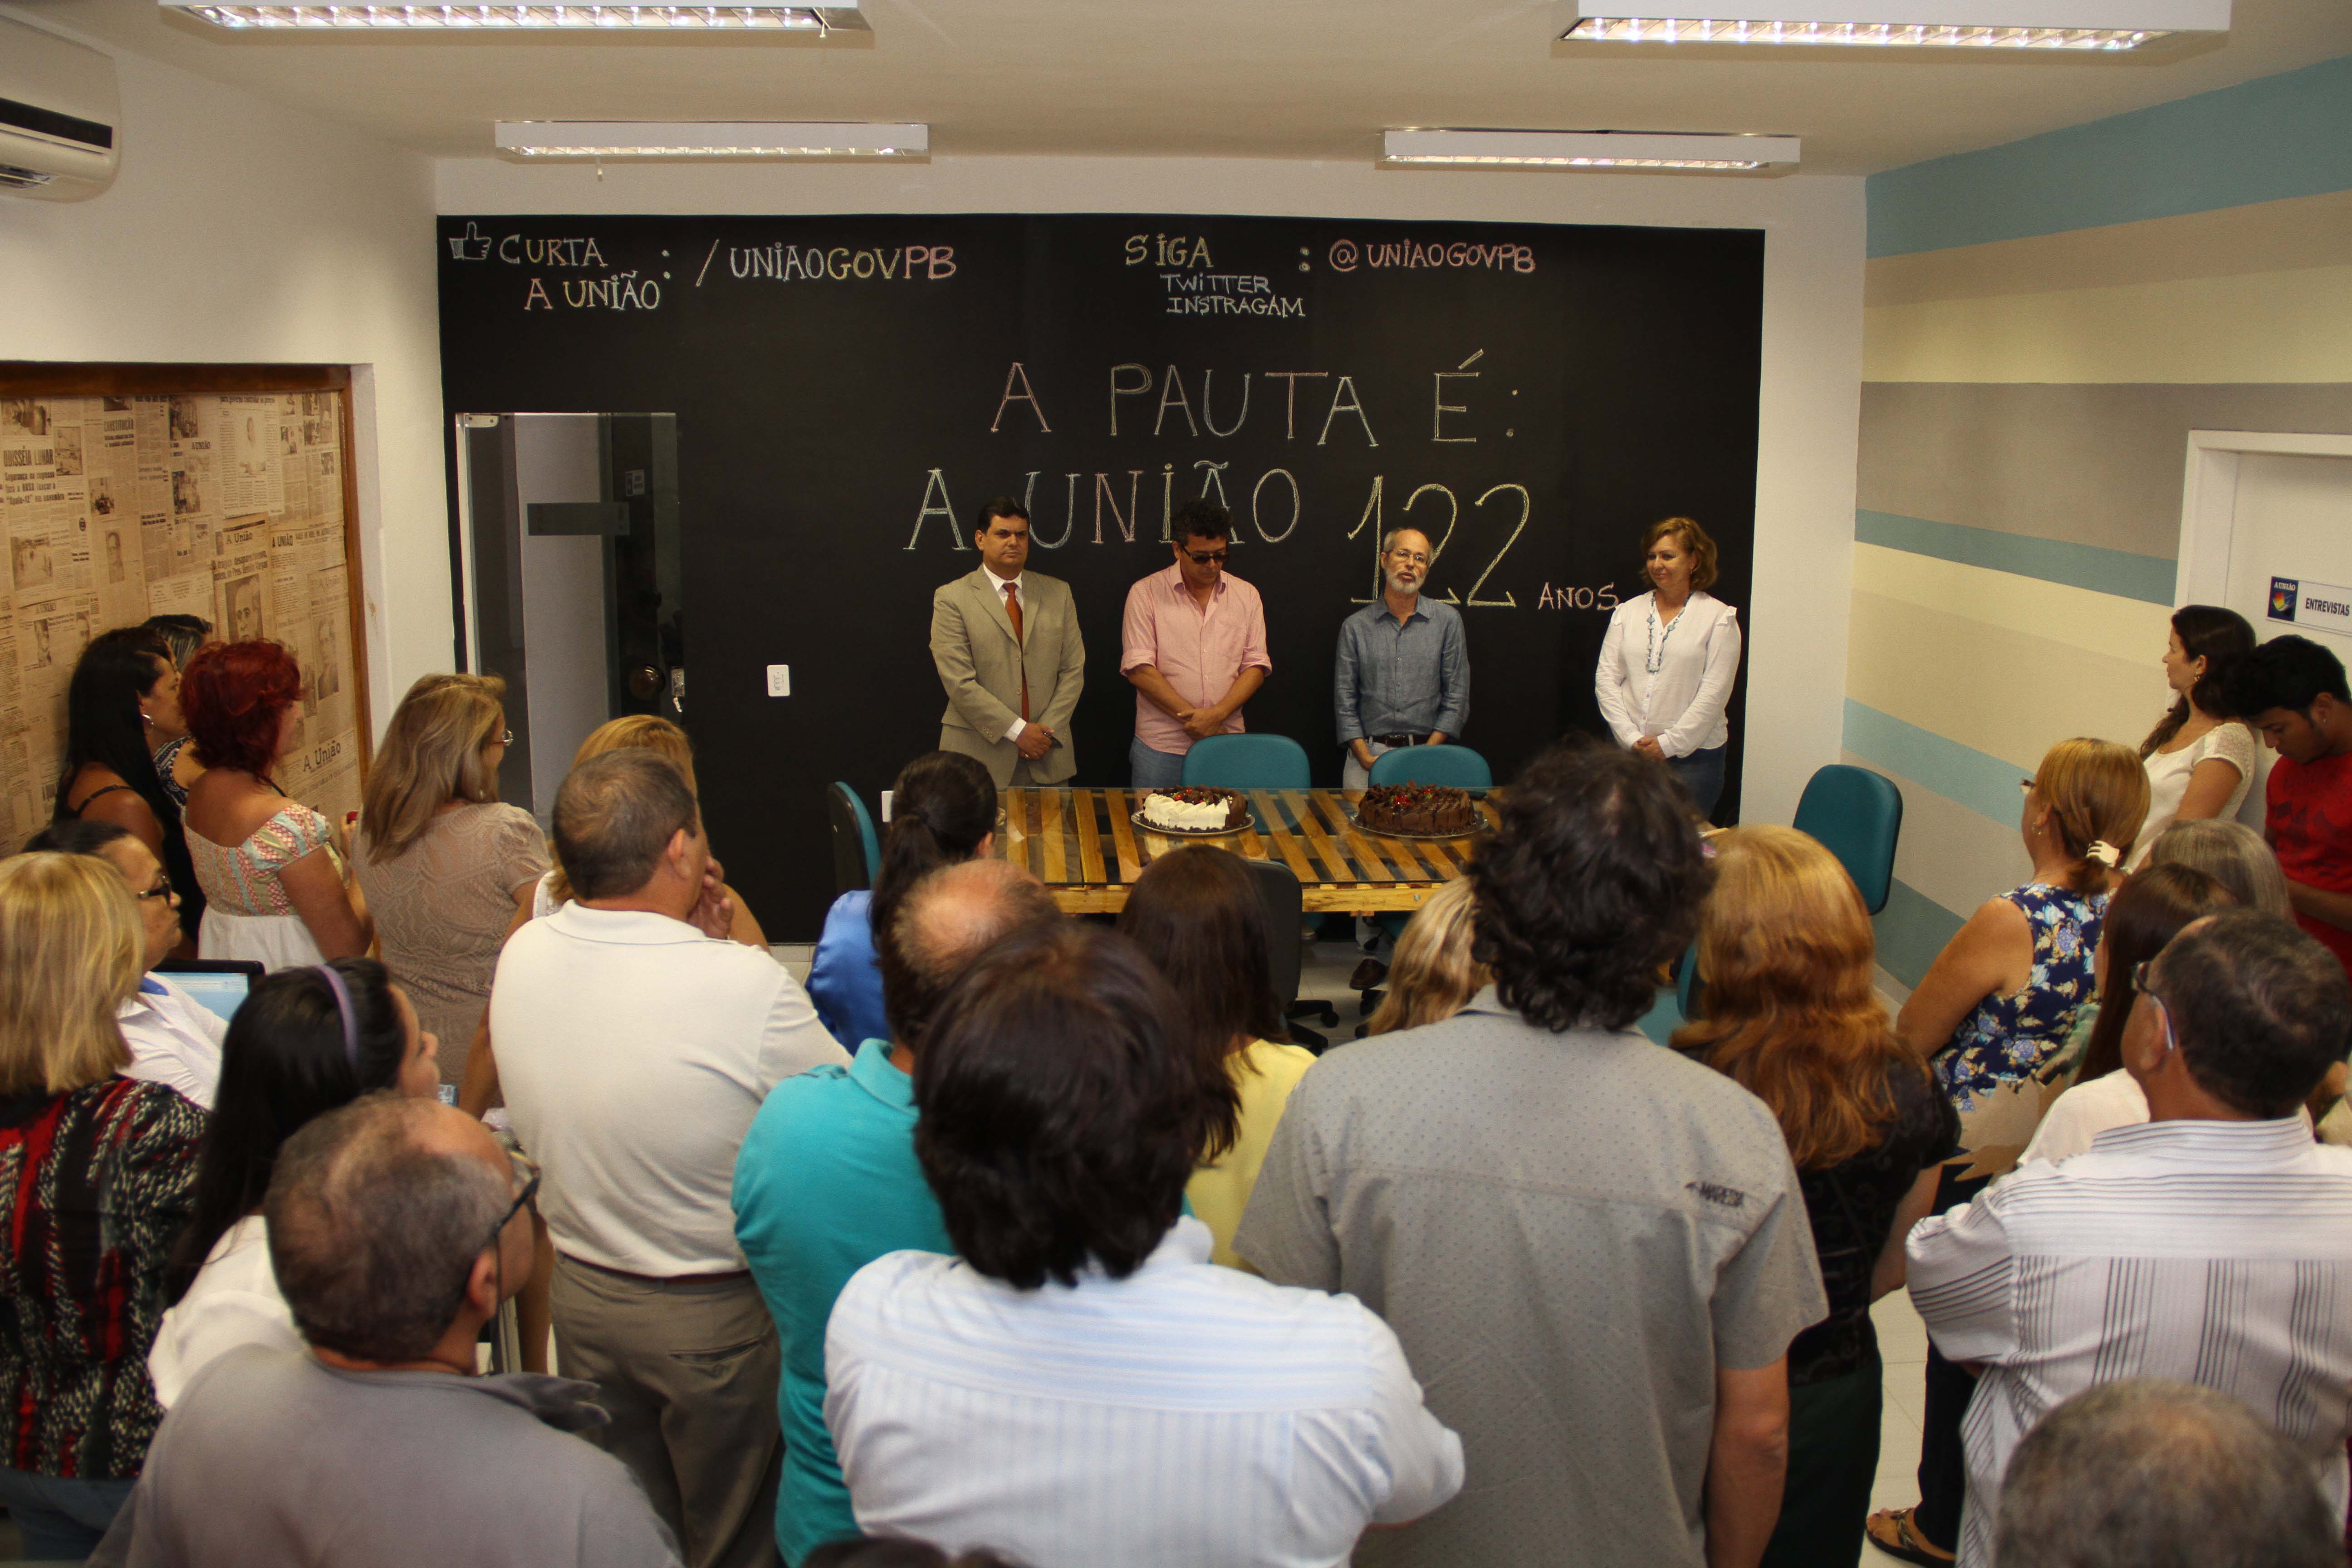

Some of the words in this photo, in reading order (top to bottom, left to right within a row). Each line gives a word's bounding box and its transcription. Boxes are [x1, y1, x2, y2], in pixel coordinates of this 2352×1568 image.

[500, 234, 608, 268] CURTA
[1125, 233, 1214, 268] SIGA
[524, 278, 553, 310] A
[563, 270, 661, 311] UNIÃO
[1166, 294, 1306, 318] INSTRAGAM
[990, 362, 1052, 433] A
[1110, 364, 1379, 447] PAUTA
[234, 530, 253, 543] União
[903, 467, 972, 551] A
[1024, 460, 1301, 549] UNIÃO
[1347, 475, 1530, 608] 122
[1538, 582, 1619, 611] ANOS
[2305, 597, 2350, 616] ENTREVISTAS
[303, 755, 312, 772] A
[314, 740, 341, 765] União
